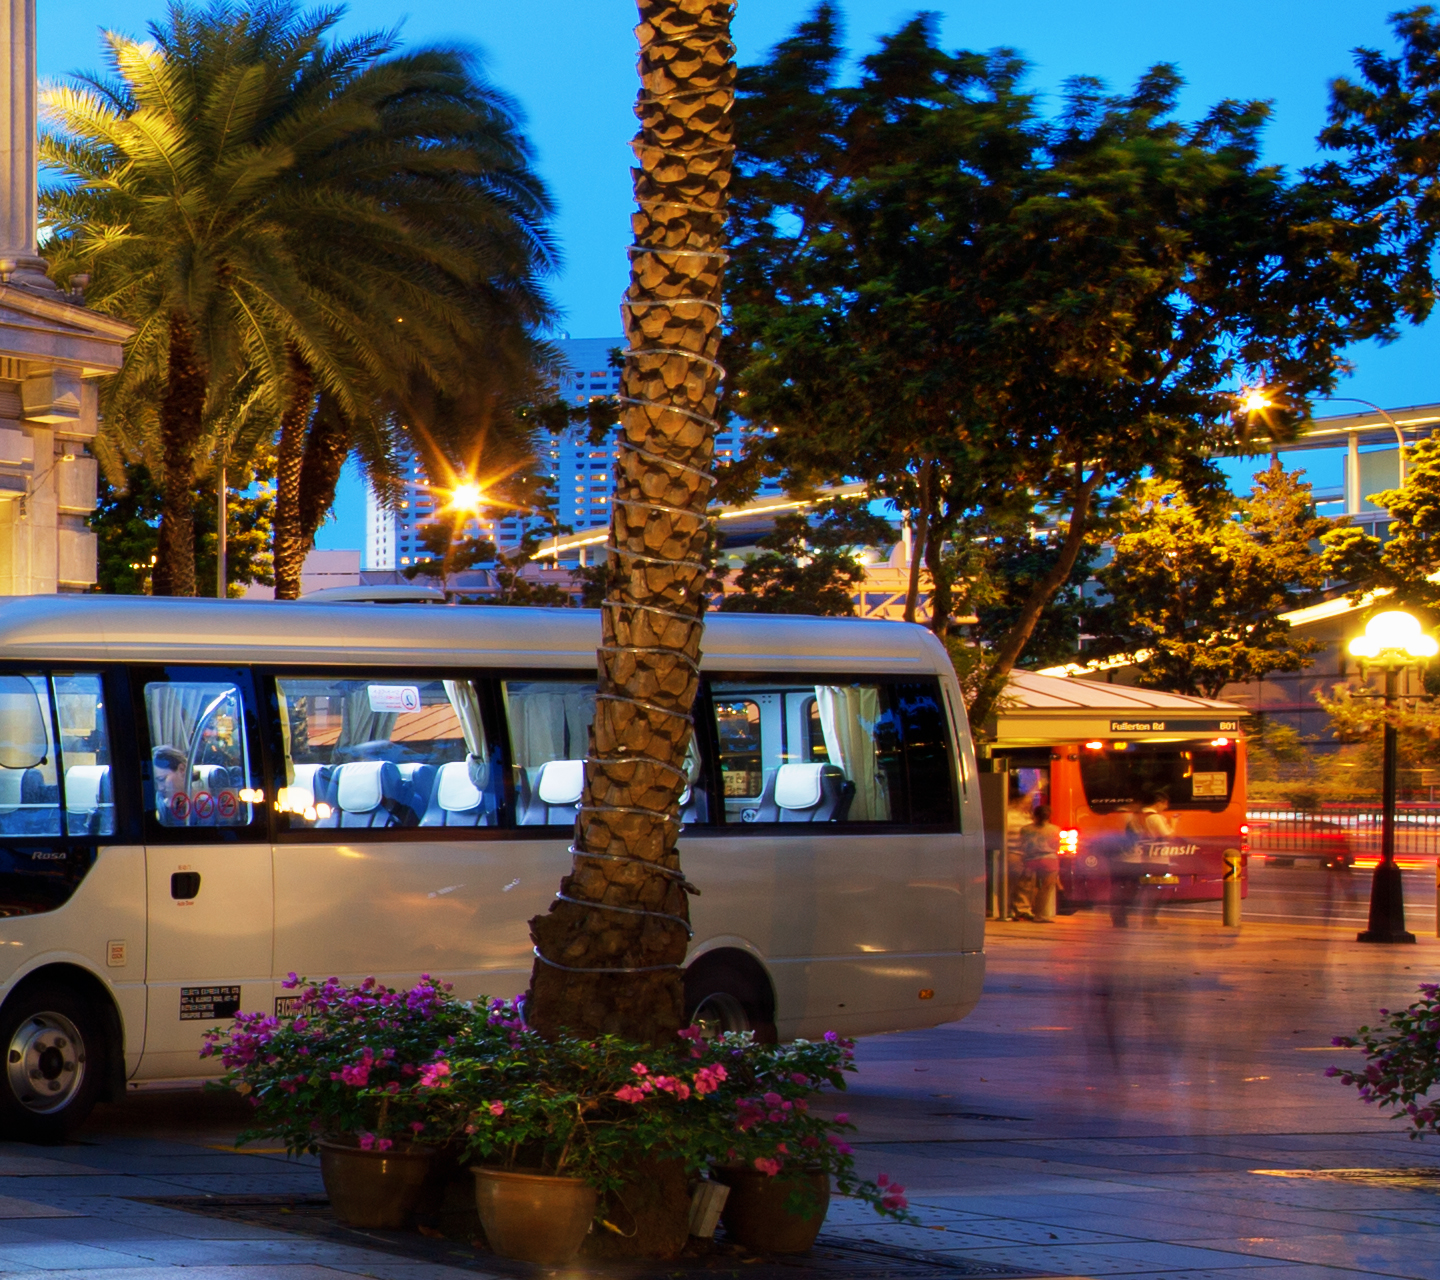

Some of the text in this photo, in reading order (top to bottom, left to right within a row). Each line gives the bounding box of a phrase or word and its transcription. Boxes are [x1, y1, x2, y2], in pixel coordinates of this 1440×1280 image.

[1111, 721, 1165, 731] Fullerton Rd
[1219, 721, 1236, 731] B01
[1148, 843, 1200, 857] Transit
